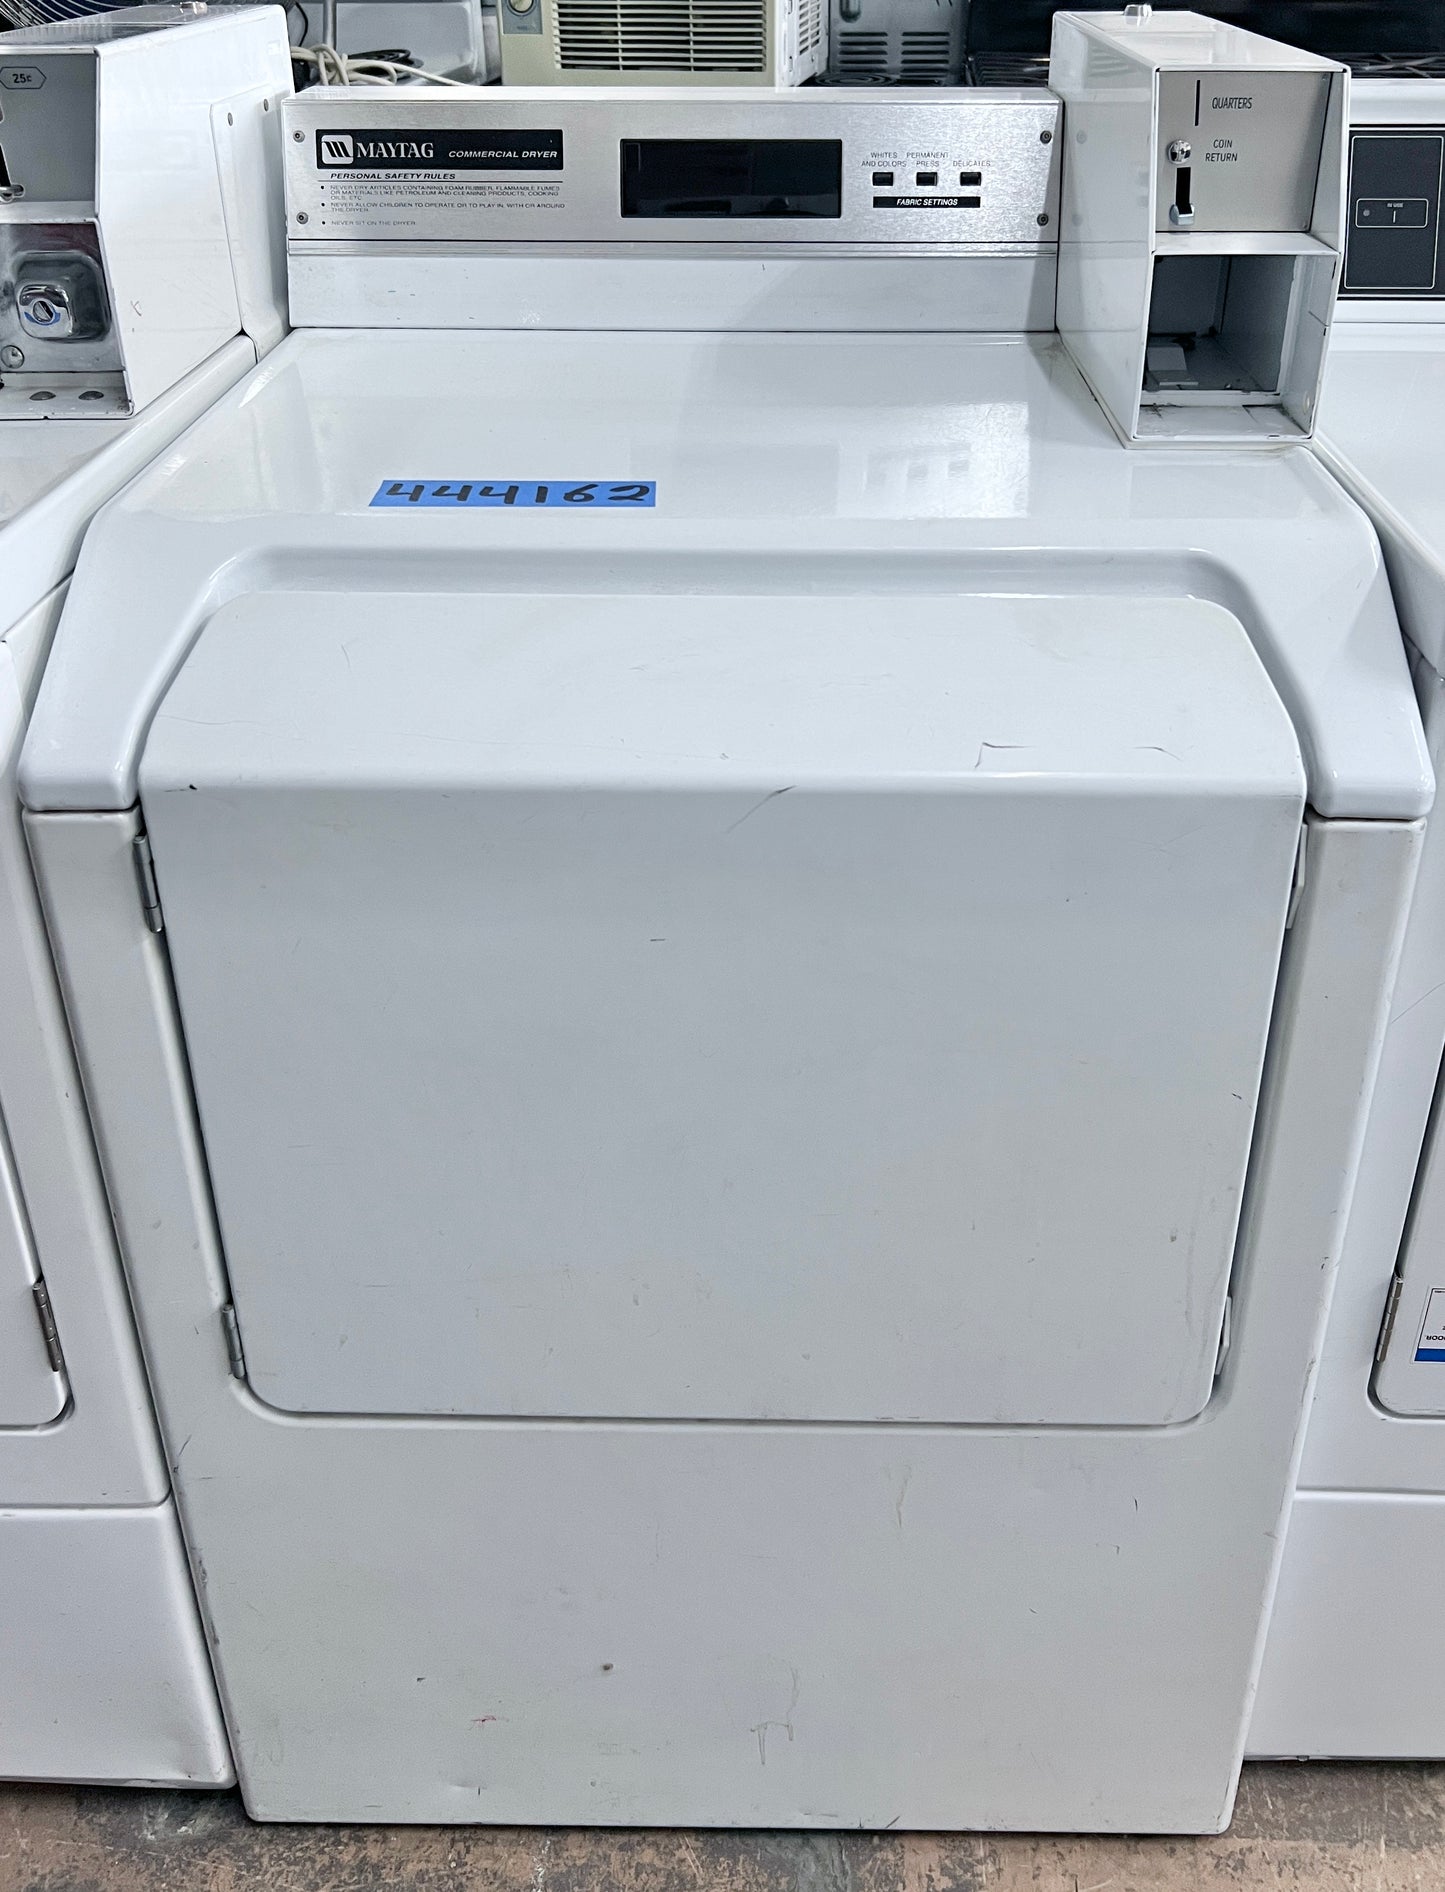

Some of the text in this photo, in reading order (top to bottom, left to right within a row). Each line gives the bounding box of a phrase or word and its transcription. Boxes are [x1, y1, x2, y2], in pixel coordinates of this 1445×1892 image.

[1212, 97, 1253, 109] QUARTERS
[1213, 139, 1233, 148] COIN
[356, 142, 434, 158] MAYTAG
[448, 150, 558, 158] COMMERCIAL DRYER
[1205, 152, 1238, 161] RETURN
[386, 483, 650, 504] 444162
